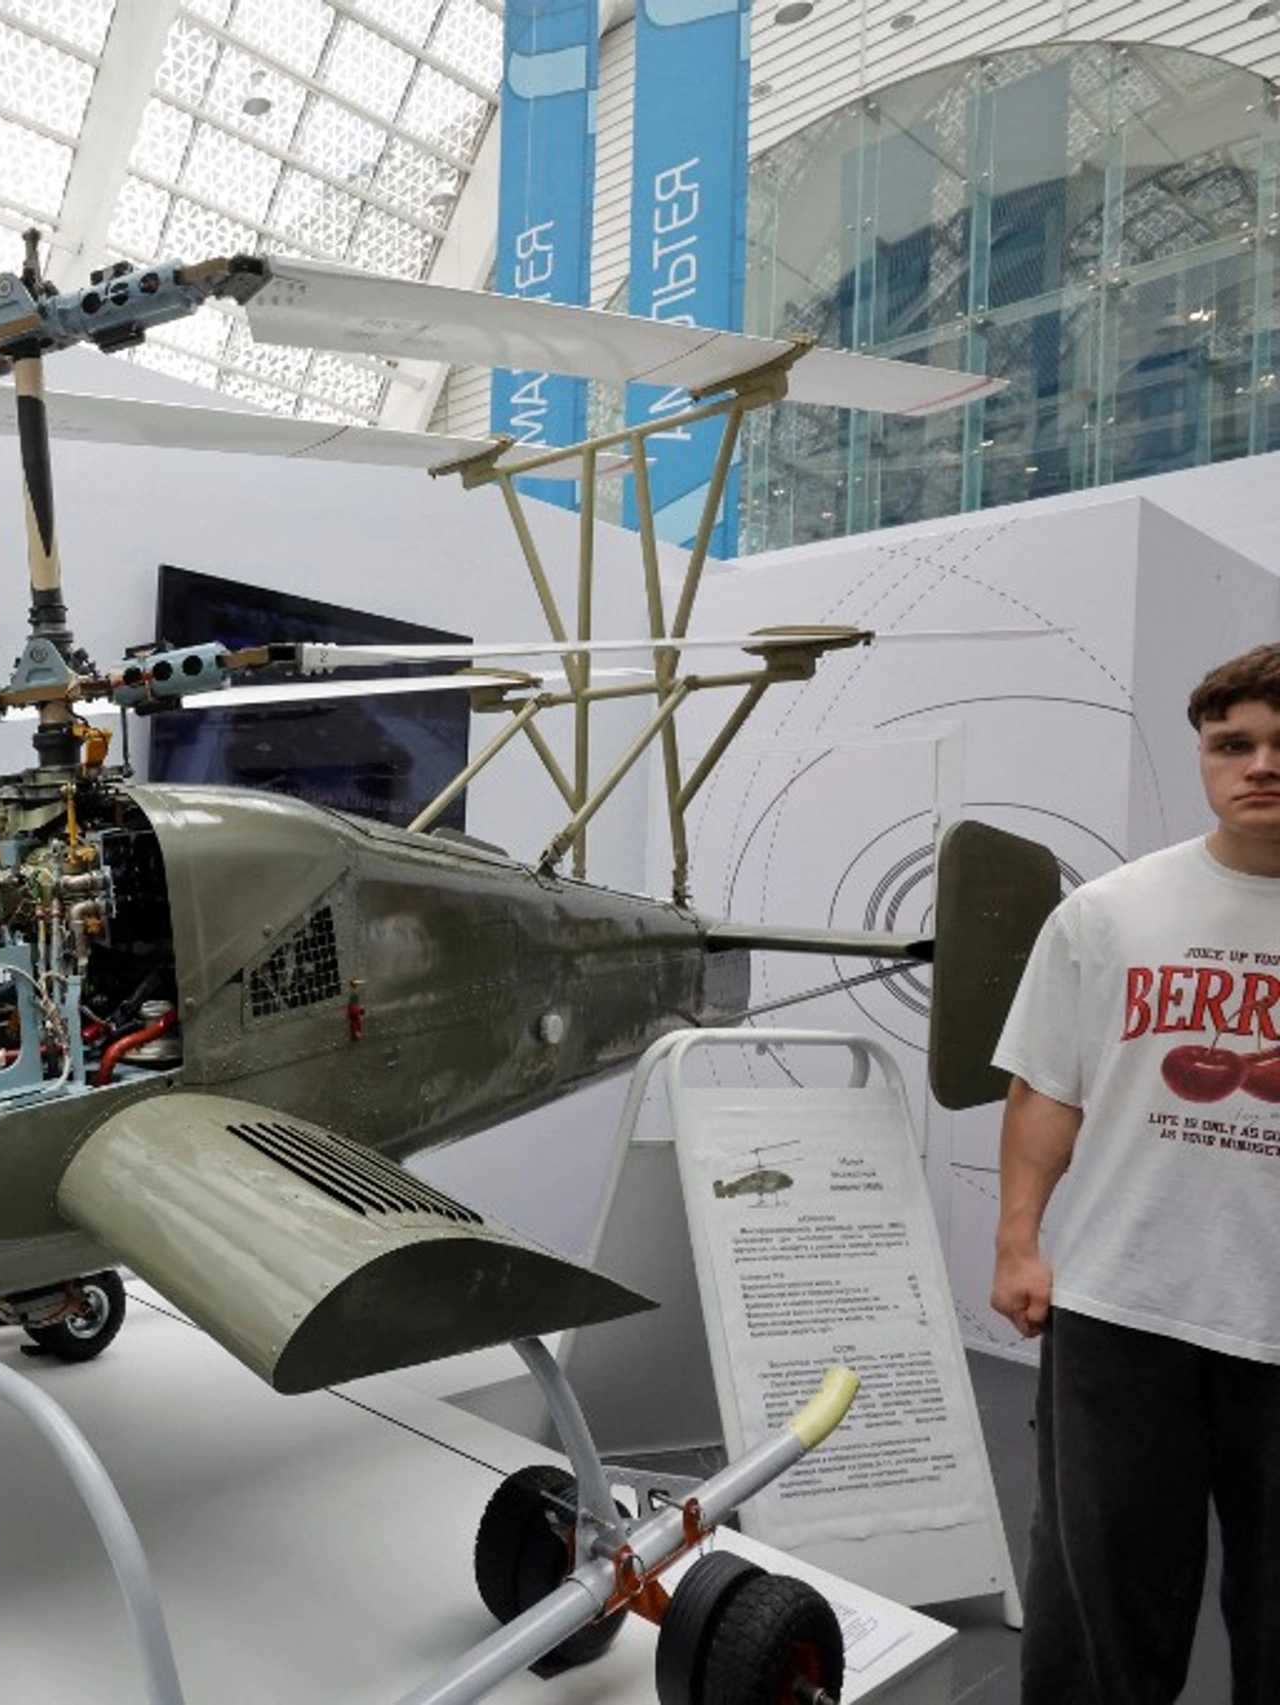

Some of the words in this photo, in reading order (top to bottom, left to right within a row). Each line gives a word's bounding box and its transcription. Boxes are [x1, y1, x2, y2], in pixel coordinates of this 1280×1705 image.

[1230, 950, 1249, 963] UP
[1148, 1113, 1179, 1127] LIFE
[1183, 1117, 1199, 1129] IS
[1202, 1120, 1237, 1136] ONLY
[1240, 1126, 1259, 1139] AS
[1182, 1131, 1217, 1147] YOUR
